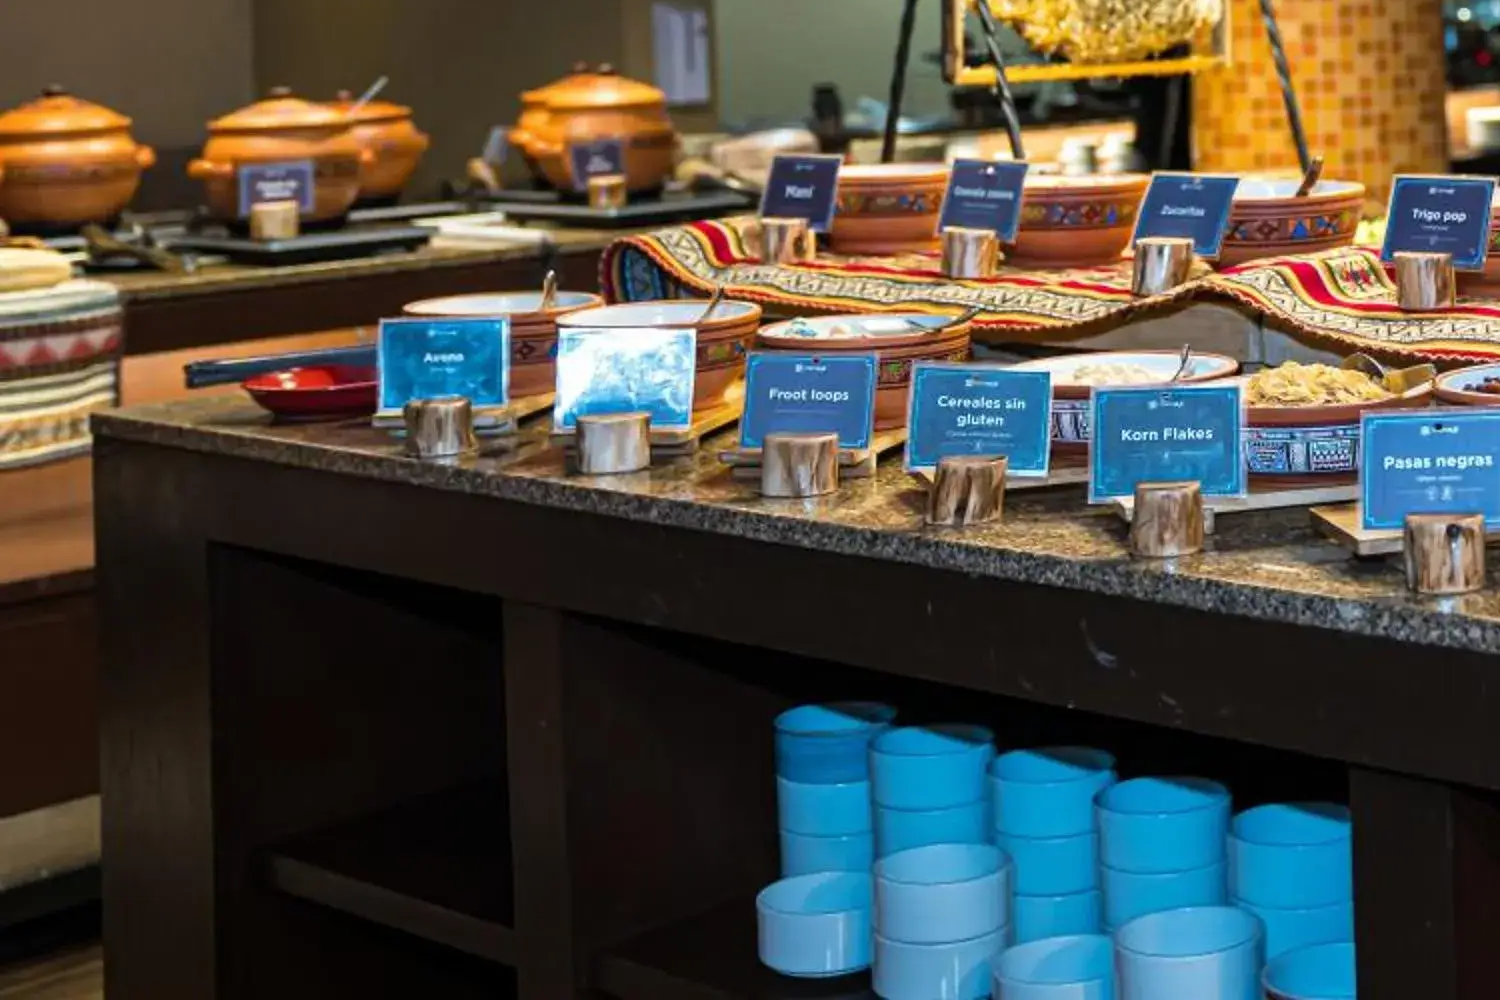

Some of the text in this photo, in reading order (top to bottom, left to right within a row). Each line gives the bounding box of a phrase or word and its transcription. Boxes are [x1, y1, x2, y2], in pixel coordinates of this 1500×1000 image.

[1412, 207, 1467, 223] Trigo pop
[423, 352, 465, 363] Avena
[769, 387, 849, 402] Froot loops
[937, 395, 1026, 410] Cereales sin
[956, 413, 1005, 427] gluten
[1121, 427, 1214, 441] Korn Flakes
[1383, 454, 1494, 470] Pasas negras
